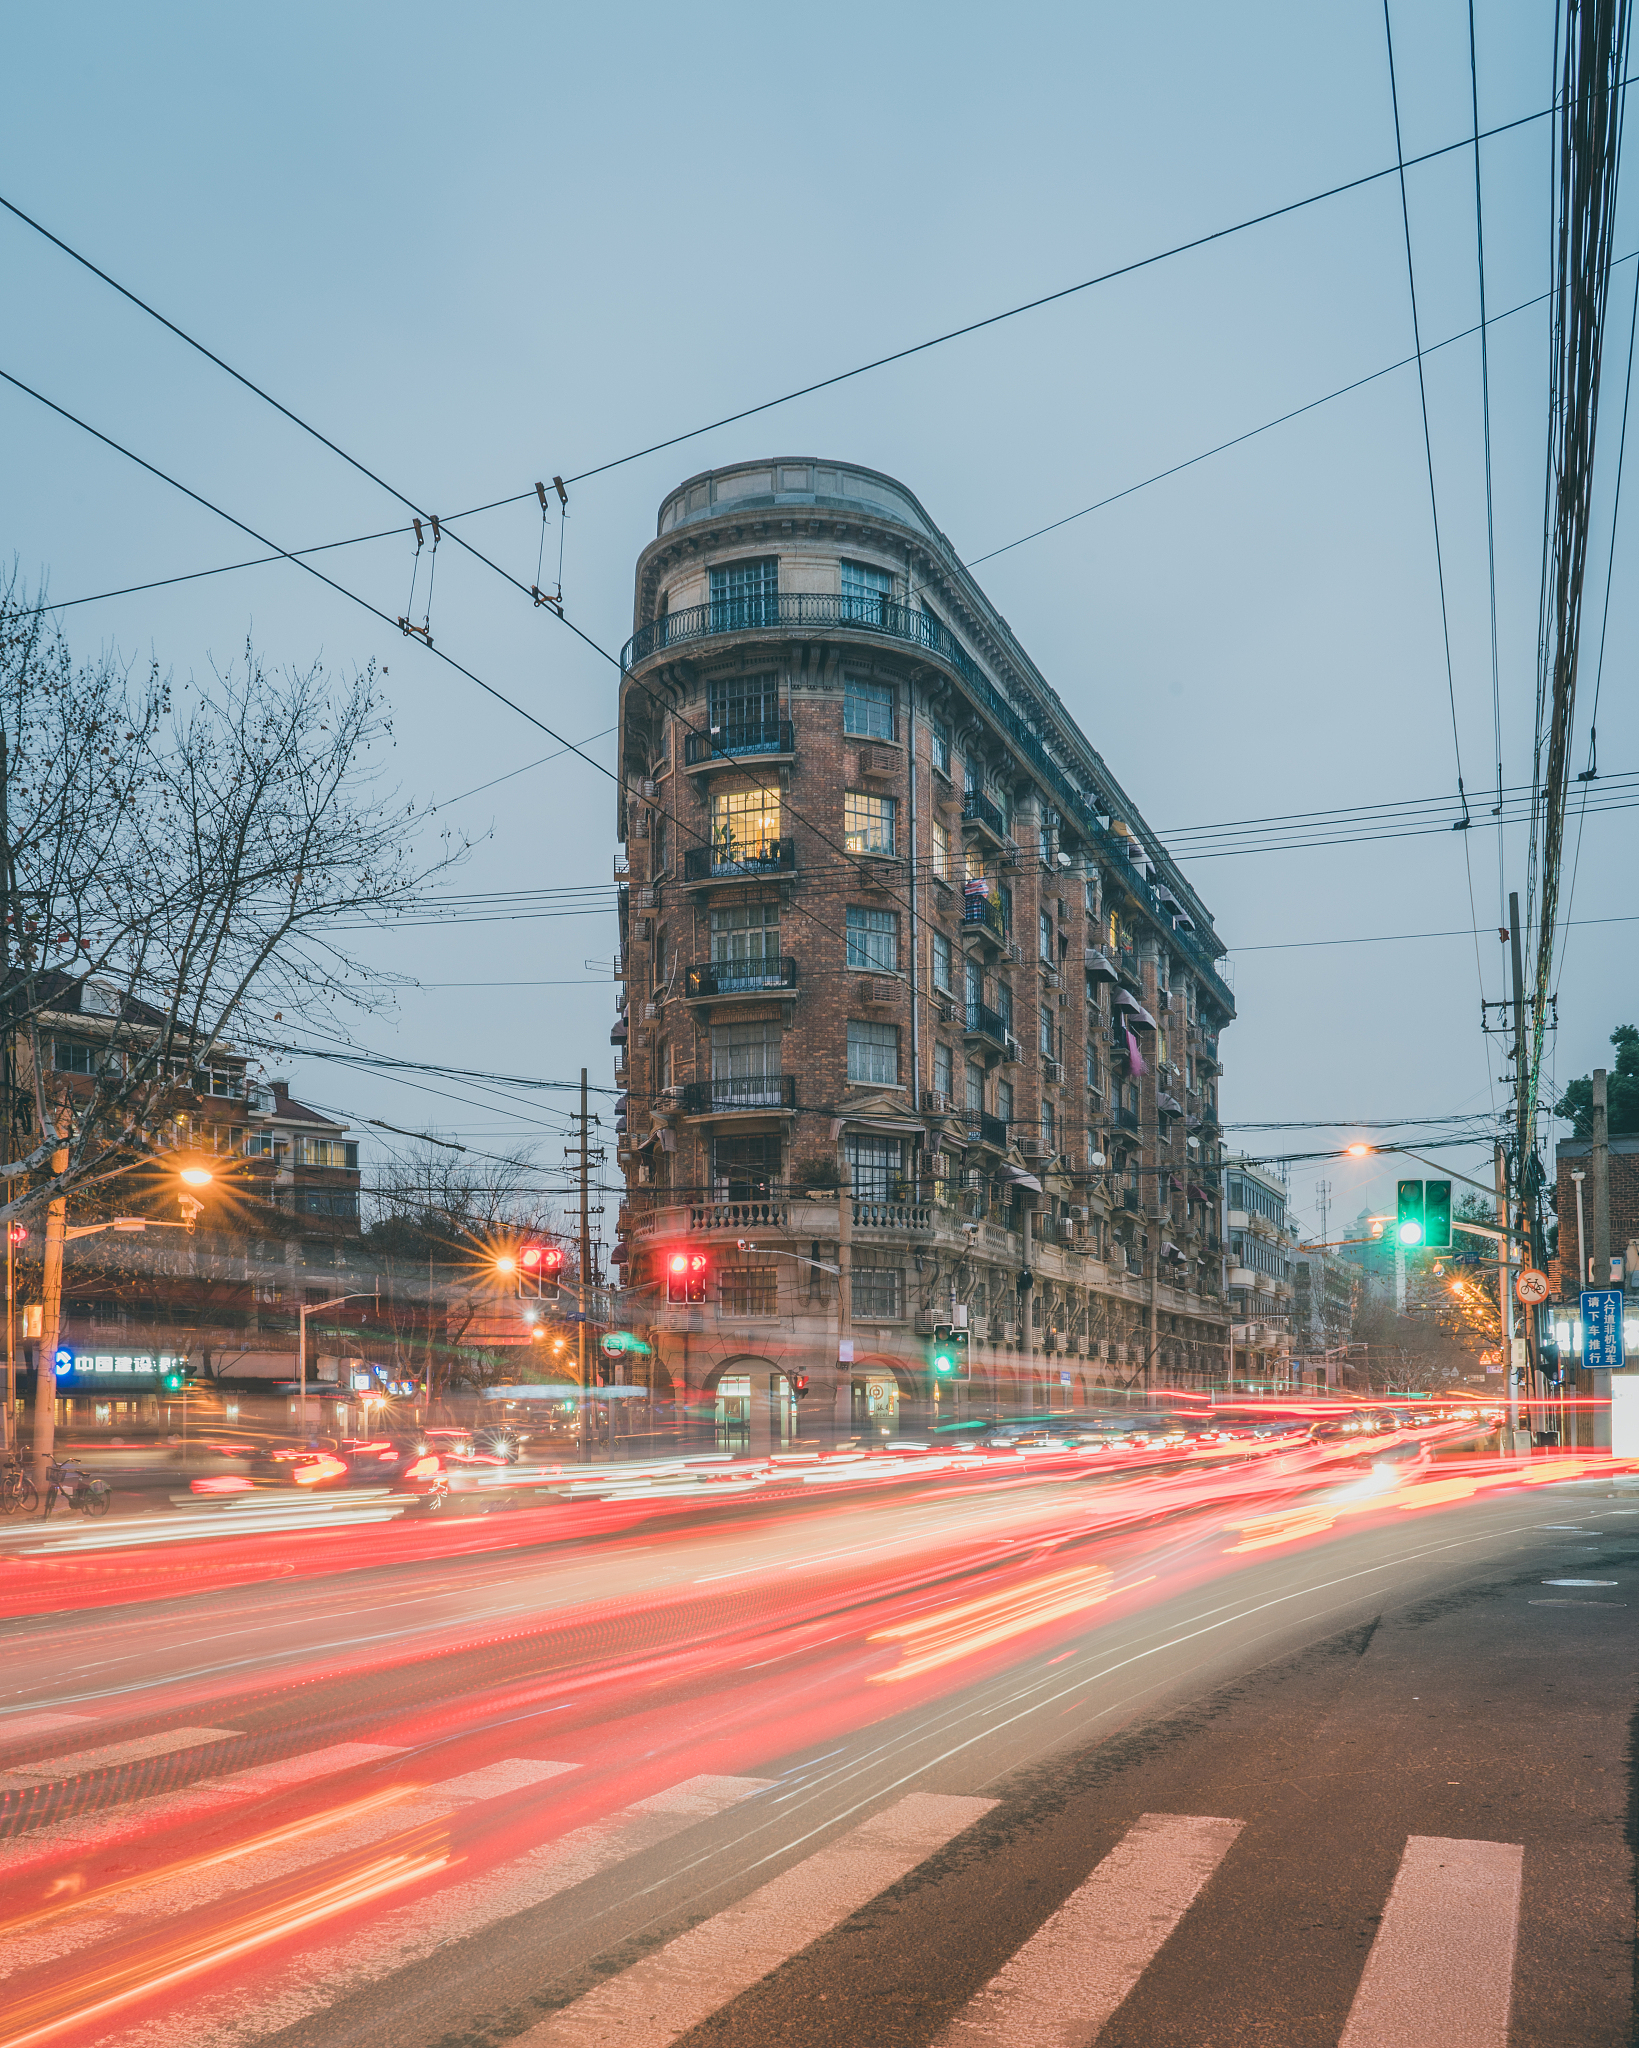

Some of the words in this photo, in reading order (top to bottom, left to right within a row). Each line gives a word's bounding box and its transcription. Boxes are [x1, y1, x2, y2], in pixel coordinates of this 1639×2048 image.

[1588, 1297, 1601, 1363] 请下车推行
[1604, 1294, 1617, 1364] 人行道非机动车
